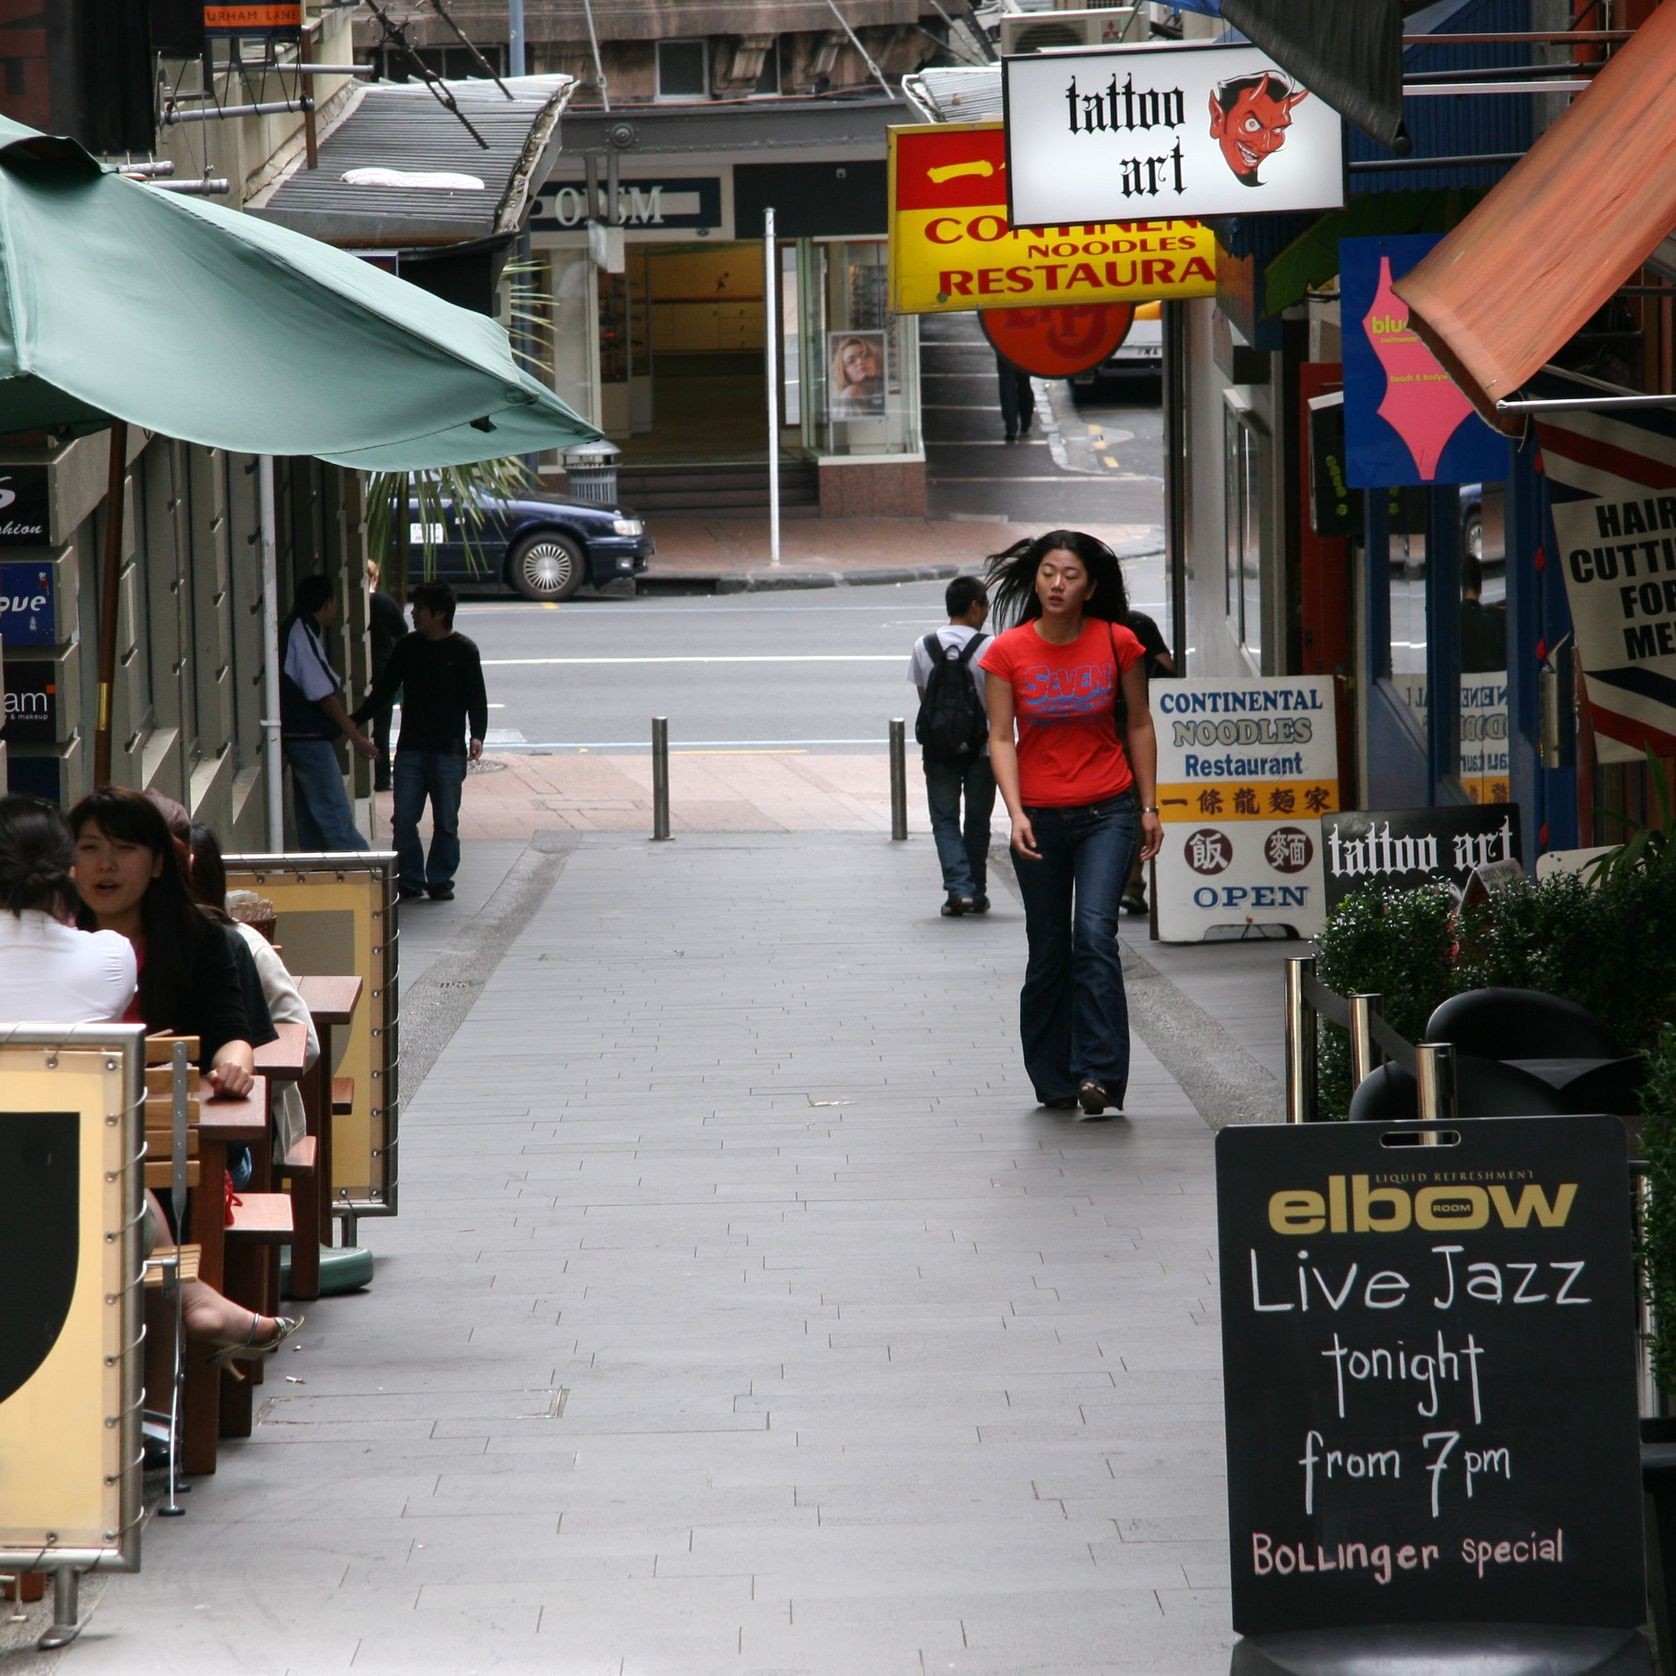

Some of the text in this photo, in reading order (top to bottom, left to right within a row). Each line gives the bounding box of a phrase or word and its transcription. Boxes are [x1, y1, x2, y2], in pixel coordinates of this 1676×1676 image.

[266, 9, 297, 20] LANE
[1065, 72, 1186, 136] tattoo
[926, 160, 1006, 184] 一
[1119, 136, 1188, 198] art
[1027, 235, 1197, 259] NOODLES
[938, 256, 1216, 297] RESTAURA
[0, 520, 43, 535] hion
[1569, 537, 1676, 584] CUTTI
[1623, 622, 1676, 661] ME
[18, 713, 49, 721] makeup
[1160, 688, 1323, 714] CONTINENTAL
[1173, 717, 1313, 747] NOODLES
[1185, 752, 1304, 778] Restaurant
[1189, 832, 1229, 870] 飯
[1328, 815, 1513, 878] tattoo art
[1194, 886, 1309, 908] OPEN
[1376, 1169, 1535, 1184] LIQUID REFRESHMENT
[1268, 1174, 1578, 1235] elbow
[1433, 1203, 1471, 1213] ROOM
[1250, 1244, 1592, 1312] Live Jazz
[1321, 1330, 1485, 1425] tonight
[1298, 1430, 1400, 1516] from
